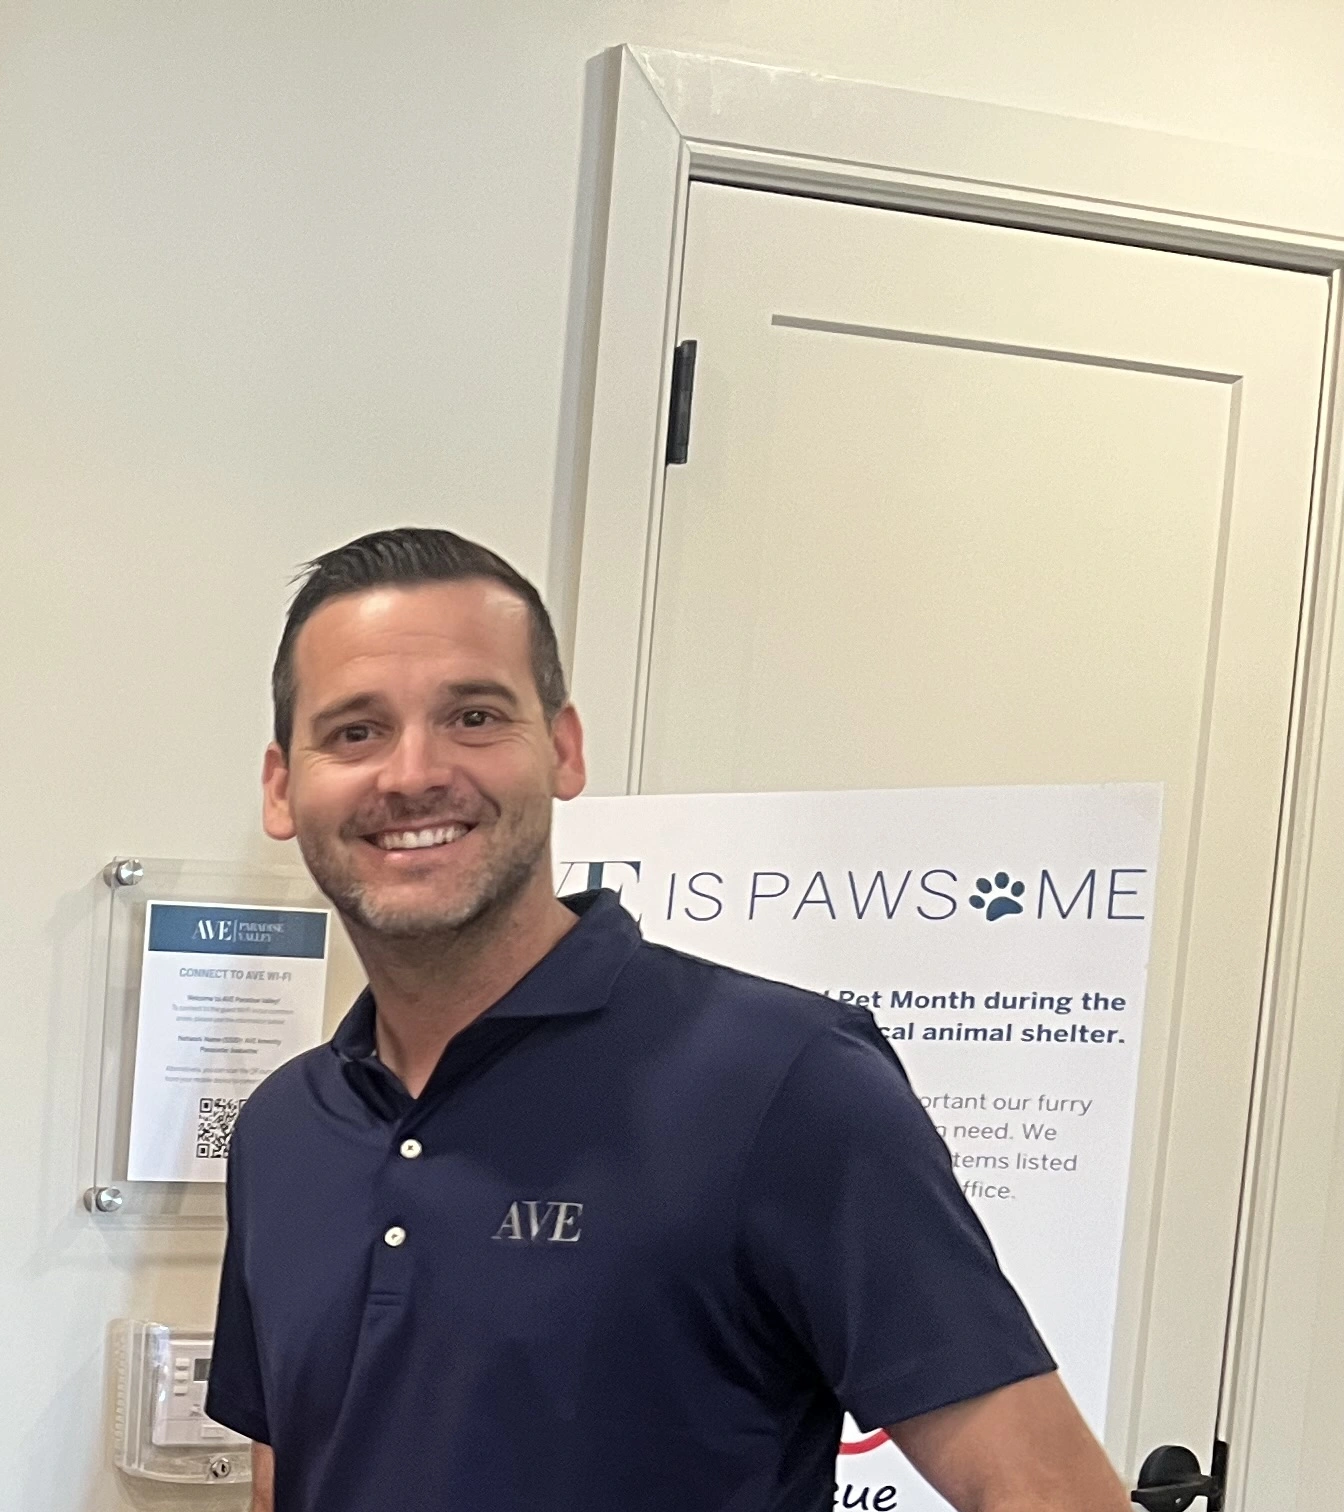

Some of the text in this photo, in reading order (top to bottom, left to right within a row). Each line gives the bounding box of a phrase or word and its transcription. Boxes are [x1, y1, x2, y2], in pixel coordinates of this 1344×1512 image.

[665, 871, 724, 921] IS
[192, 920, 232, 940] AVE
[180, 968, 291, 982] CONNECT TO AVE WI-FI
[838, 990, 1127, 1014] Pet Month during the
[879, 1022, 1126, 1044] cal animal shelter.
[920, 1094, 1093, 1116] ortant our furry
[936, 1123, 1057, 1140] n need. We
[953, 1153, 1078, 1171] tems listed
[963, 1180, 1016, 1199] ffice.
[491, 1201, 584, 1242] AVE
